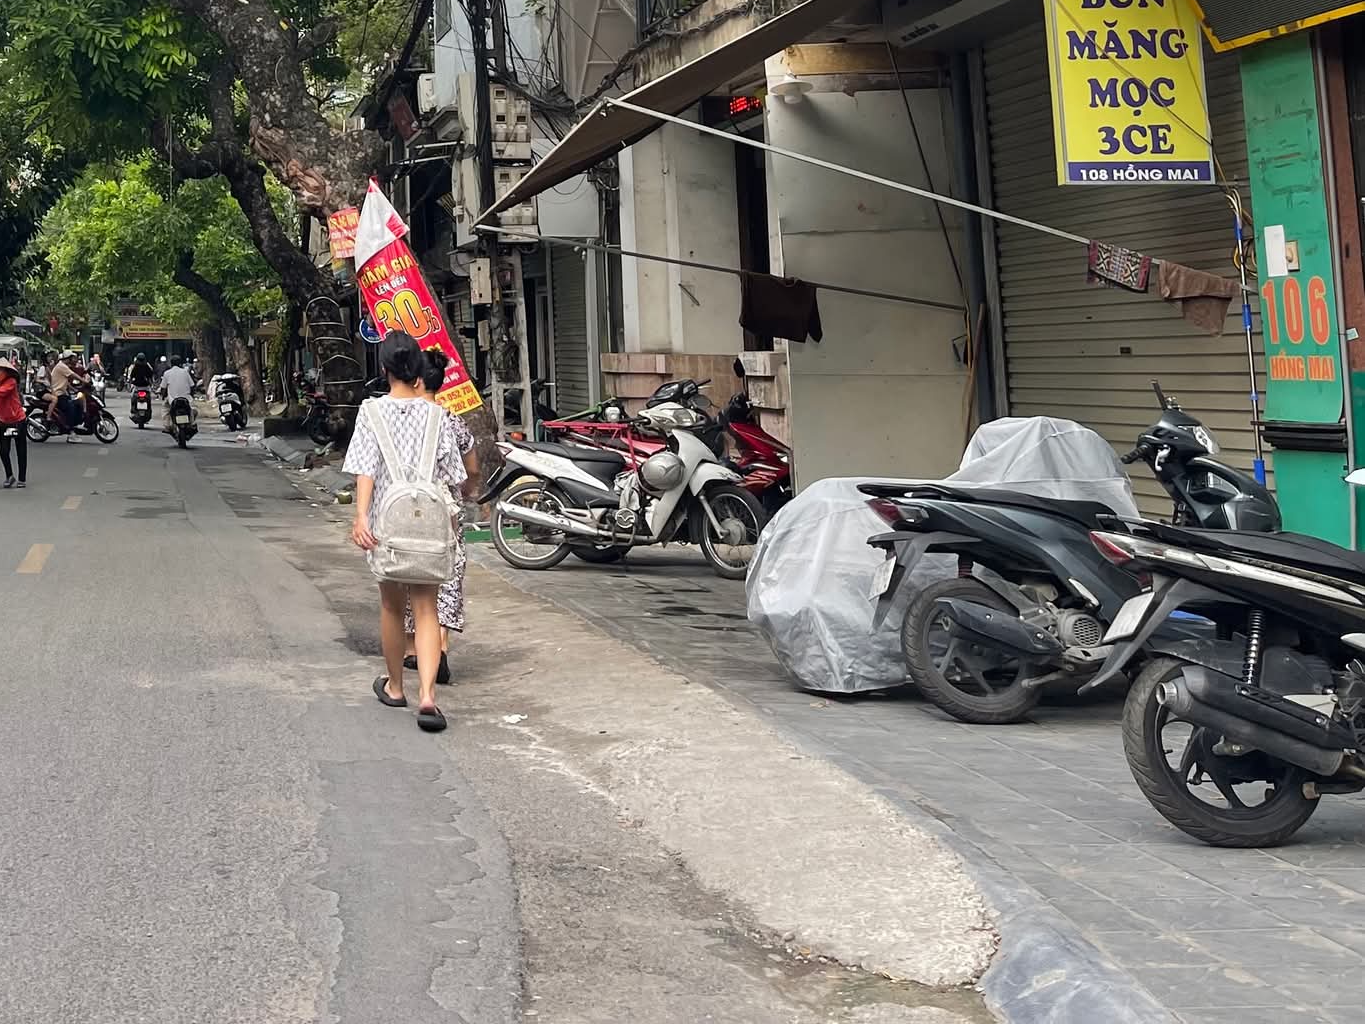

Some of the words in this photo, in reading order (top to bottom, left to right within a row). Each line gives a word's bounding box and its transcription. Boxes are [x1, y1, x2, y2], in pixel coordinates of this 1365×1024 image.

[1066, 19, 1189, 60] MĂNG
[1087, 77, 1176, 117] MỌC
[1098, 124, 1175, 155] 3CE
[1080, 168, 1109, 181] 108
[1113, 163, 1163, 181] HỒNG
[1167, 168, 1199, 181] MAI
[1262, 275, 1331, 345] 106
[1307, 355, 1336, 381] MAI
